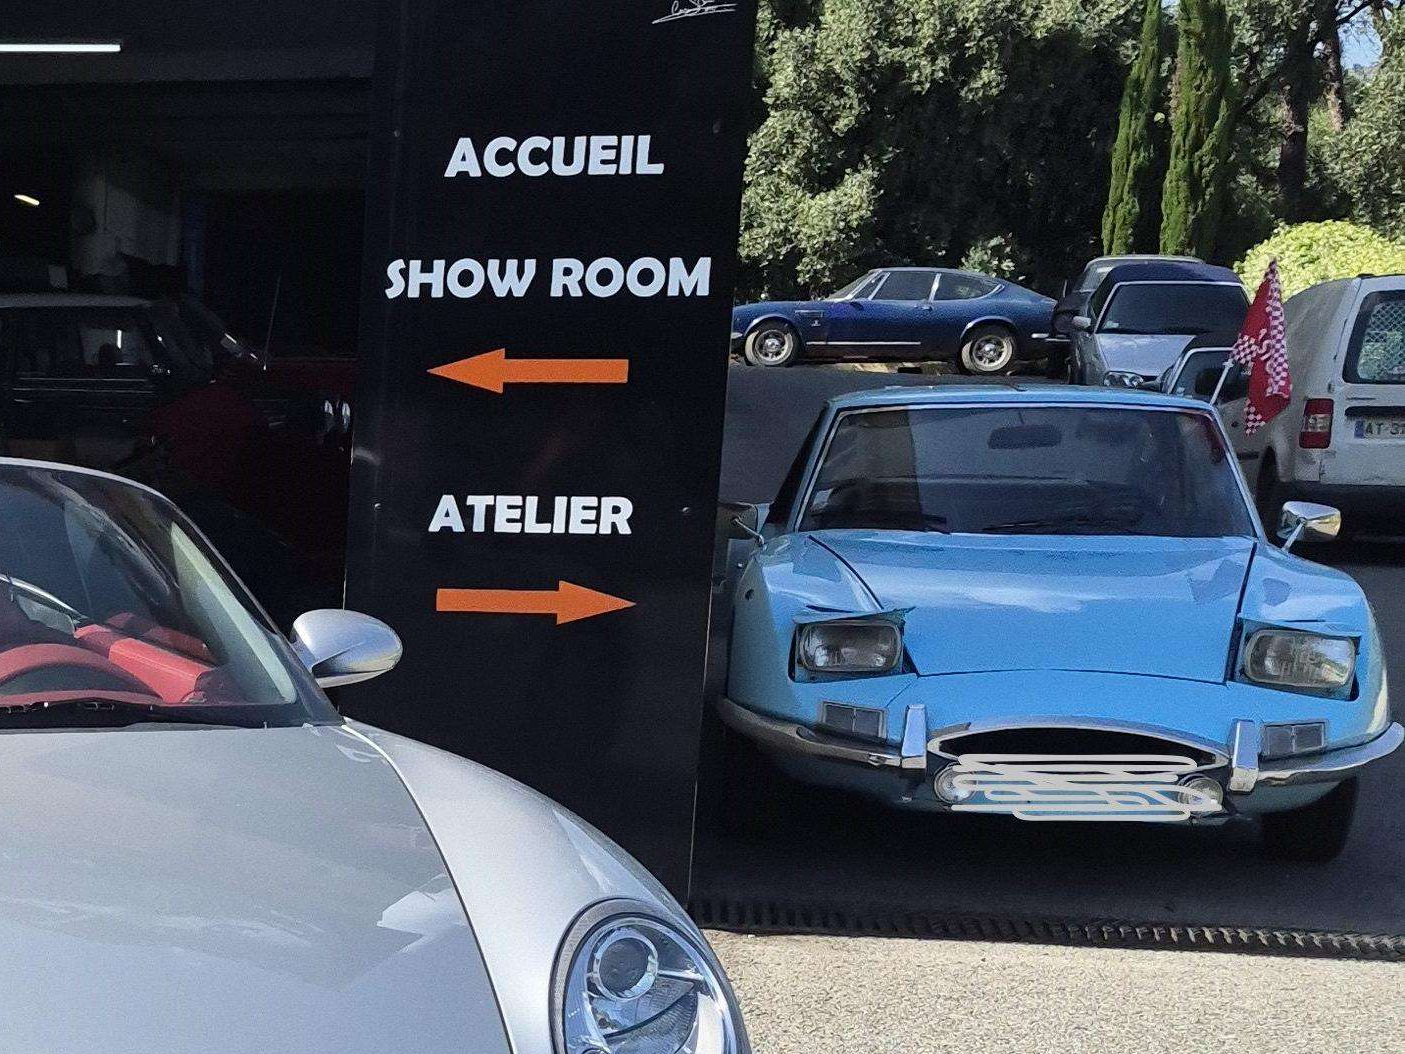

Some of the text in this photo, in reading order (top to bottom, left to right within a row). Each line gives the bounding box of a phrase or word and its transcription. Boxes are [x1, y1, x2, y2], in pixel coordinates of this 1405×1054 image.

[443, 134, 665, 178] ACCUEIL
[385, 256, 712, 300] SHOW ROOM
[1365, 421, 1405, 435] AT-3
[427, 494, 634, 535] ATELIER
